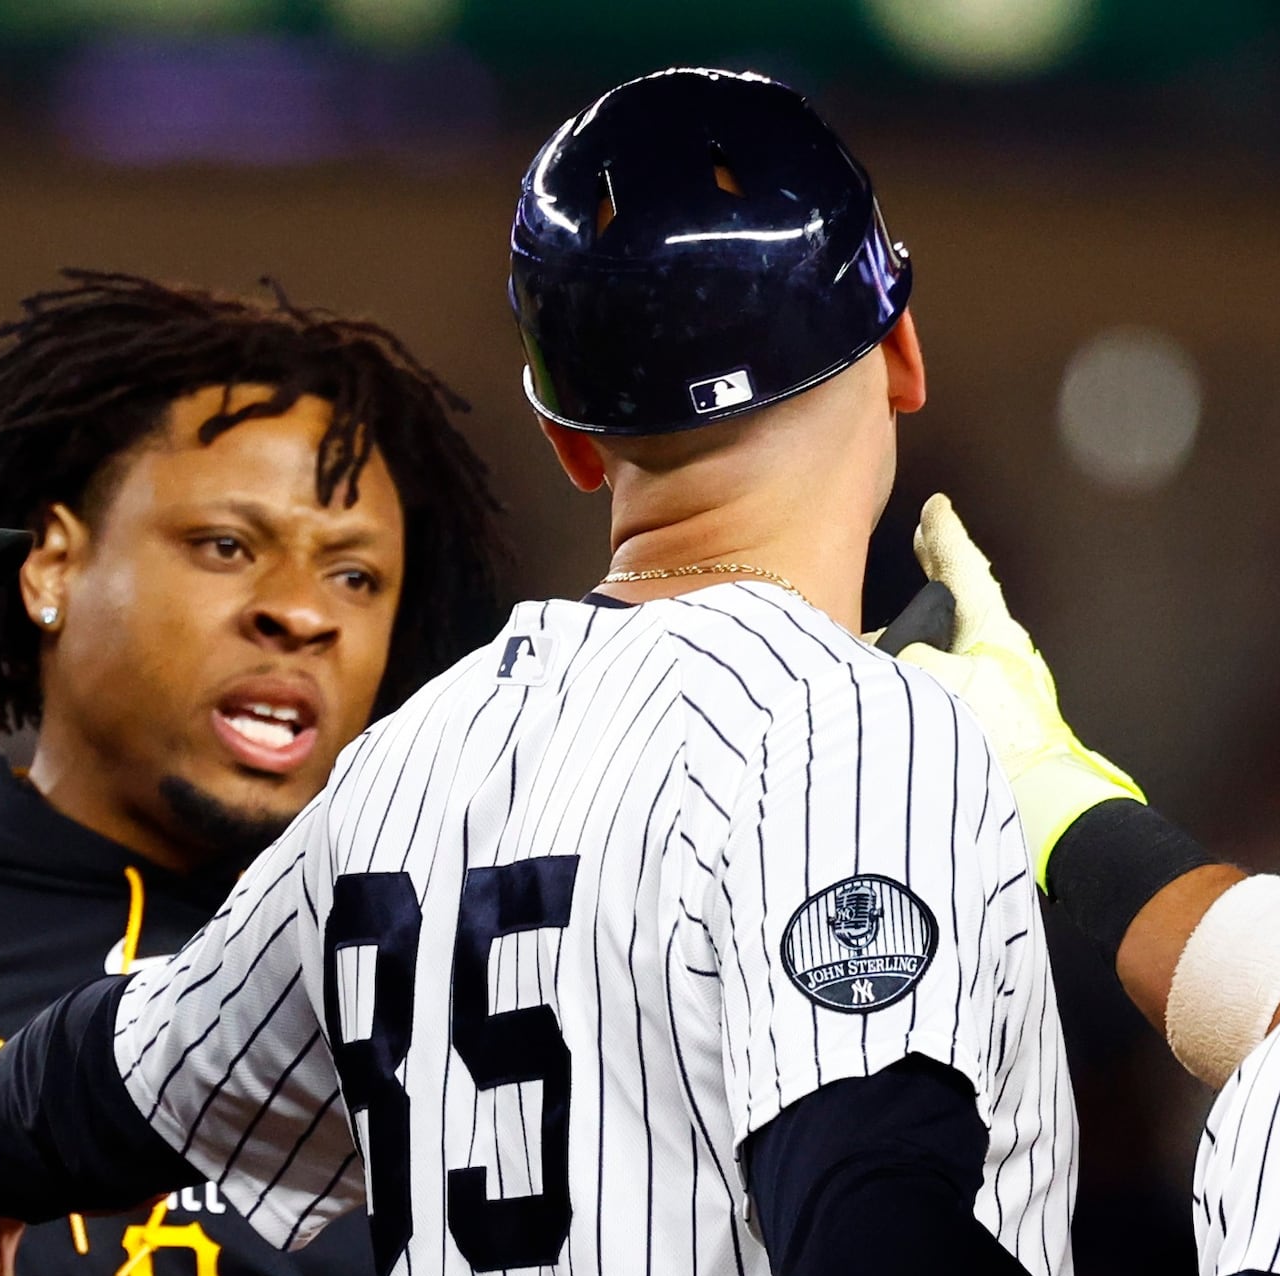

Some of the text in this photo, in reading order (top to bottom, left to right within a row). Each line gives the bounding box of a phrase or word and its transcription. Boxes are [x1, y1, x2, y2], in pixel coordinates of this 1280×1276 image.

[806, 957, 918, 989] JOHN STERLING
[851, 978, 876, 1004] NY
